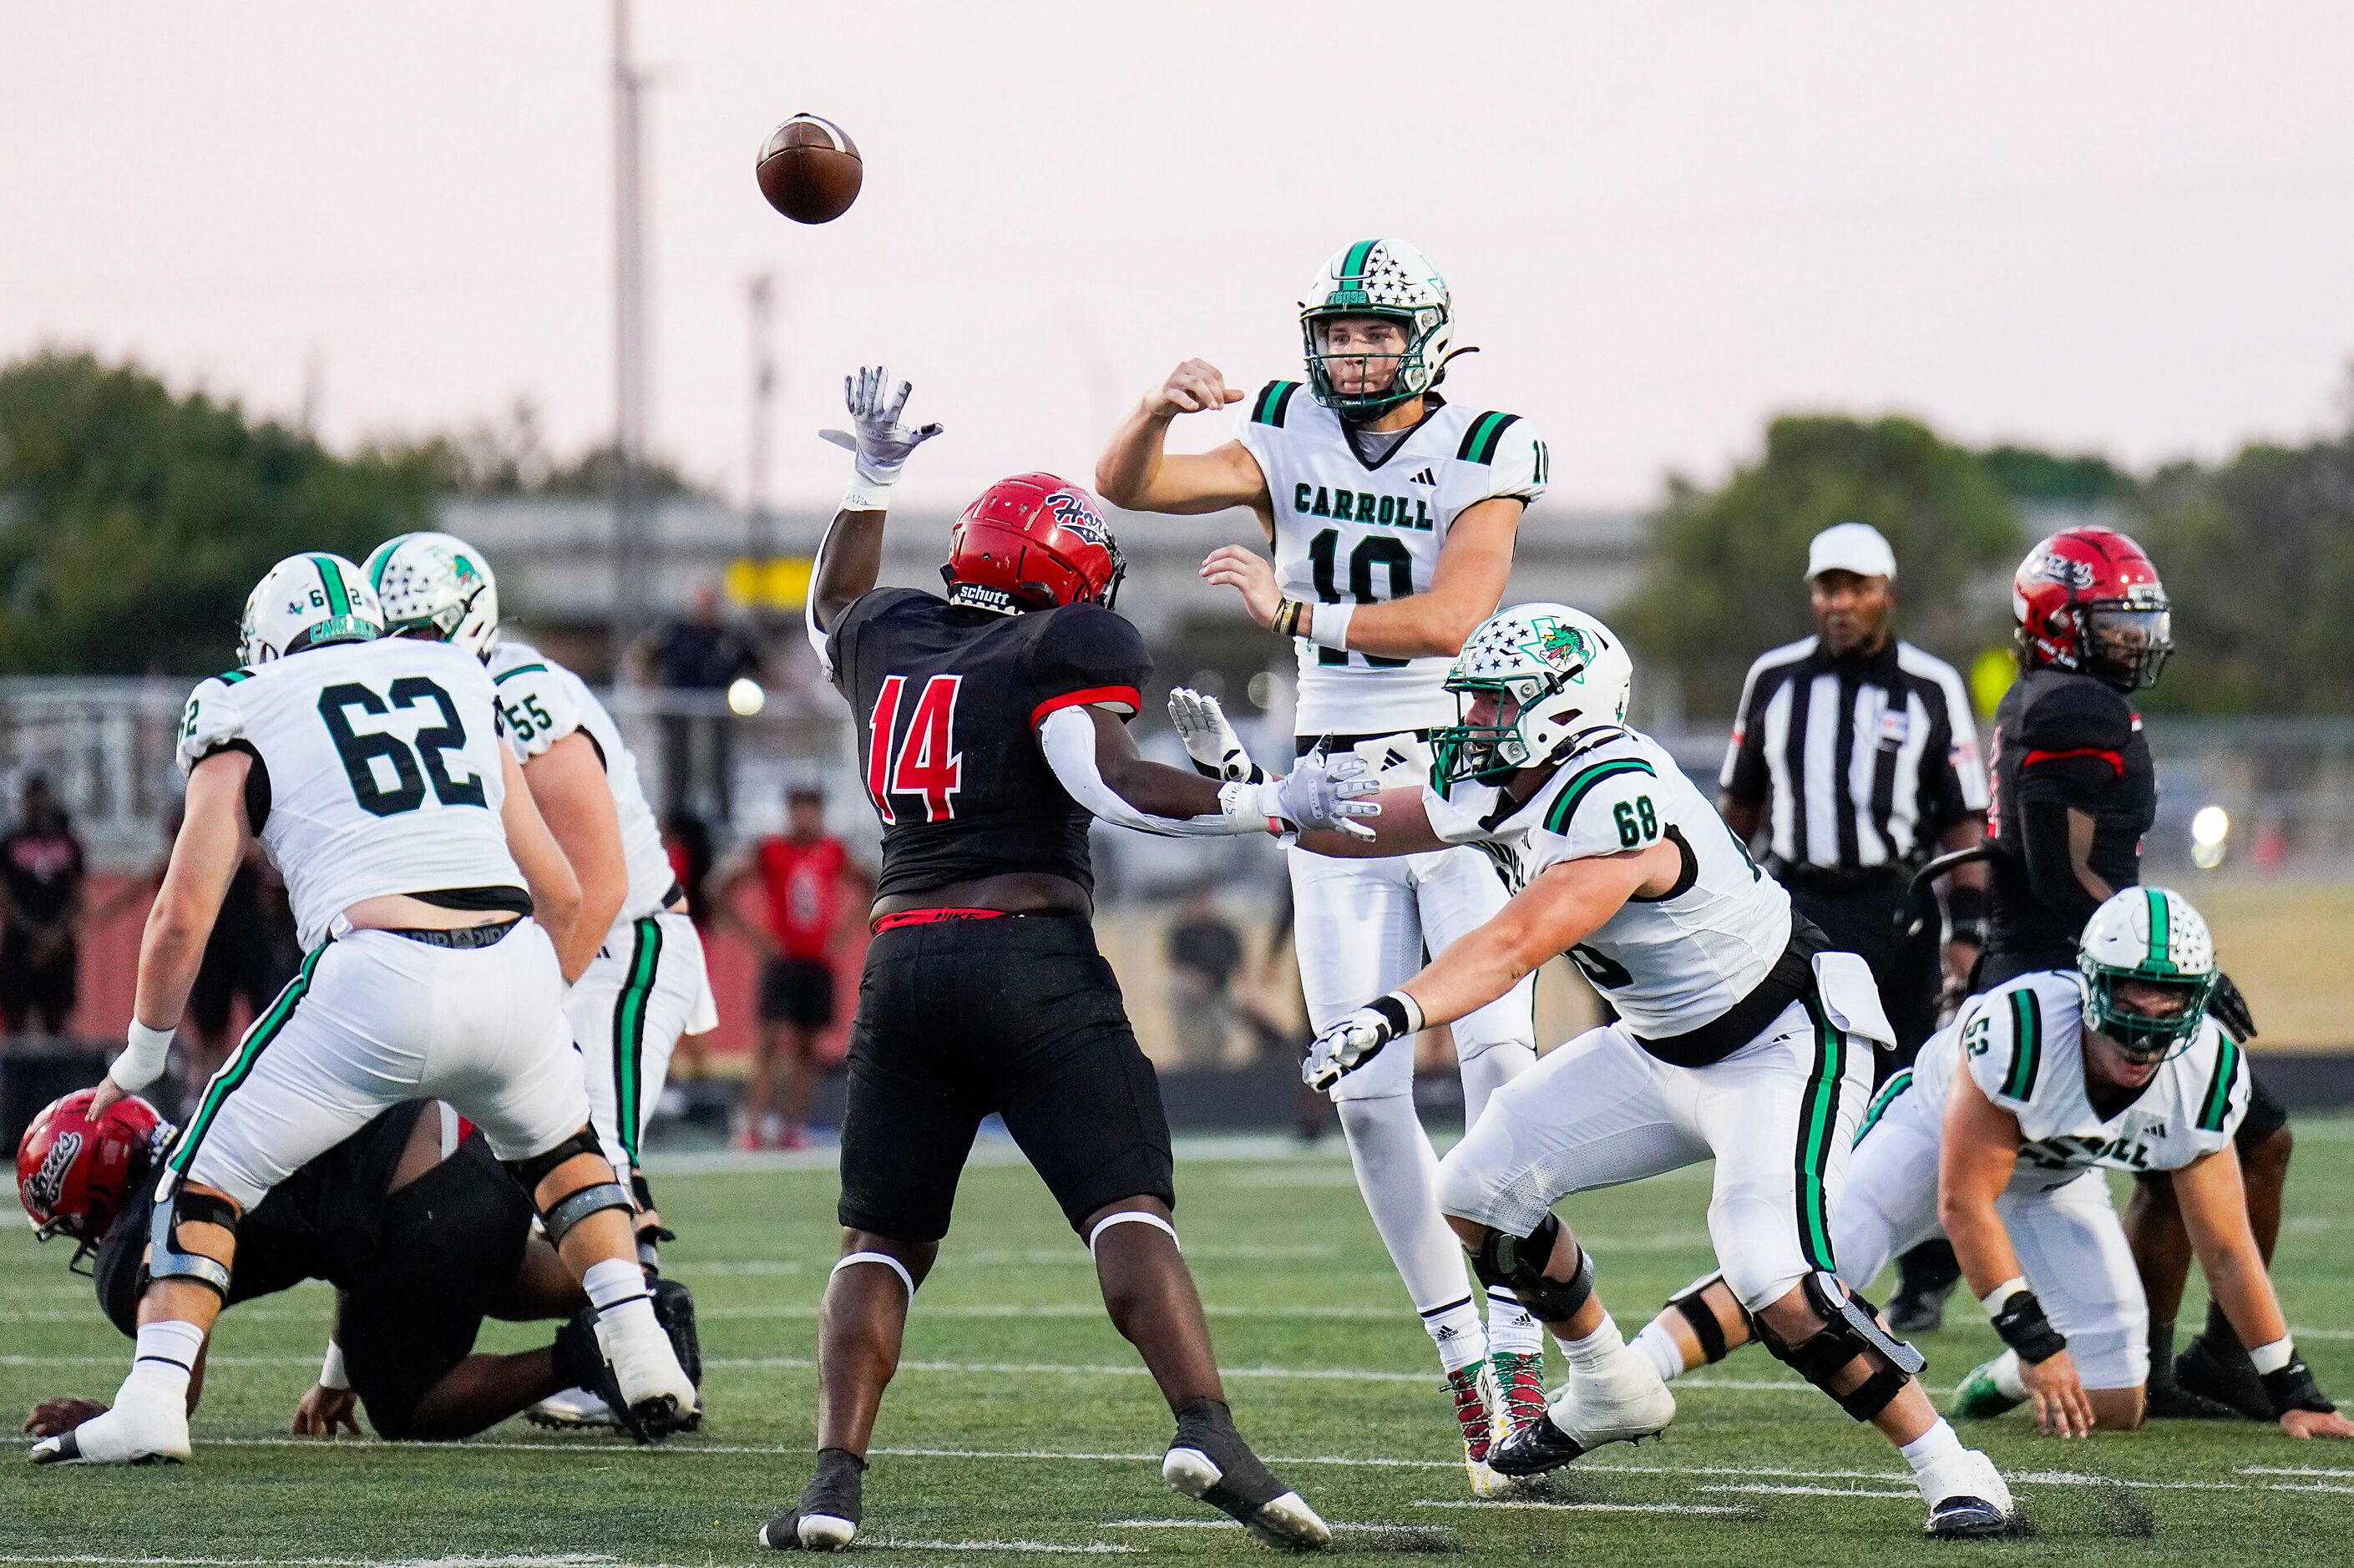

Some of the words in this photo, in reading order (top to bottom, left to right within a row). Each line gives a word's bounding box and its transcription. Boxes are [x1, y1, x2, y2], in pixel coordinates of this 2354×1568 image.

[1329, 291, 1367, 304] 76092
[1045, 493, 1107, 534] Hor
[1294, 482, 1434, 532] CARROLL
[959, 584, 1010, 605] schutt
[1308, 529, 1414, 668] 10
[183, 698, 200, 739] 2
[504, 693, 553, 742] 55
[316, 676, 489, 818] 62
[867, 674, 964, 827] 14
[1612, 794, 1658, 848] 68
[934, 912, 981, 921] NIKE
[1964, 1015, 1991, 1063] 52
[1436, 1328, 1459, 1342] adidas
